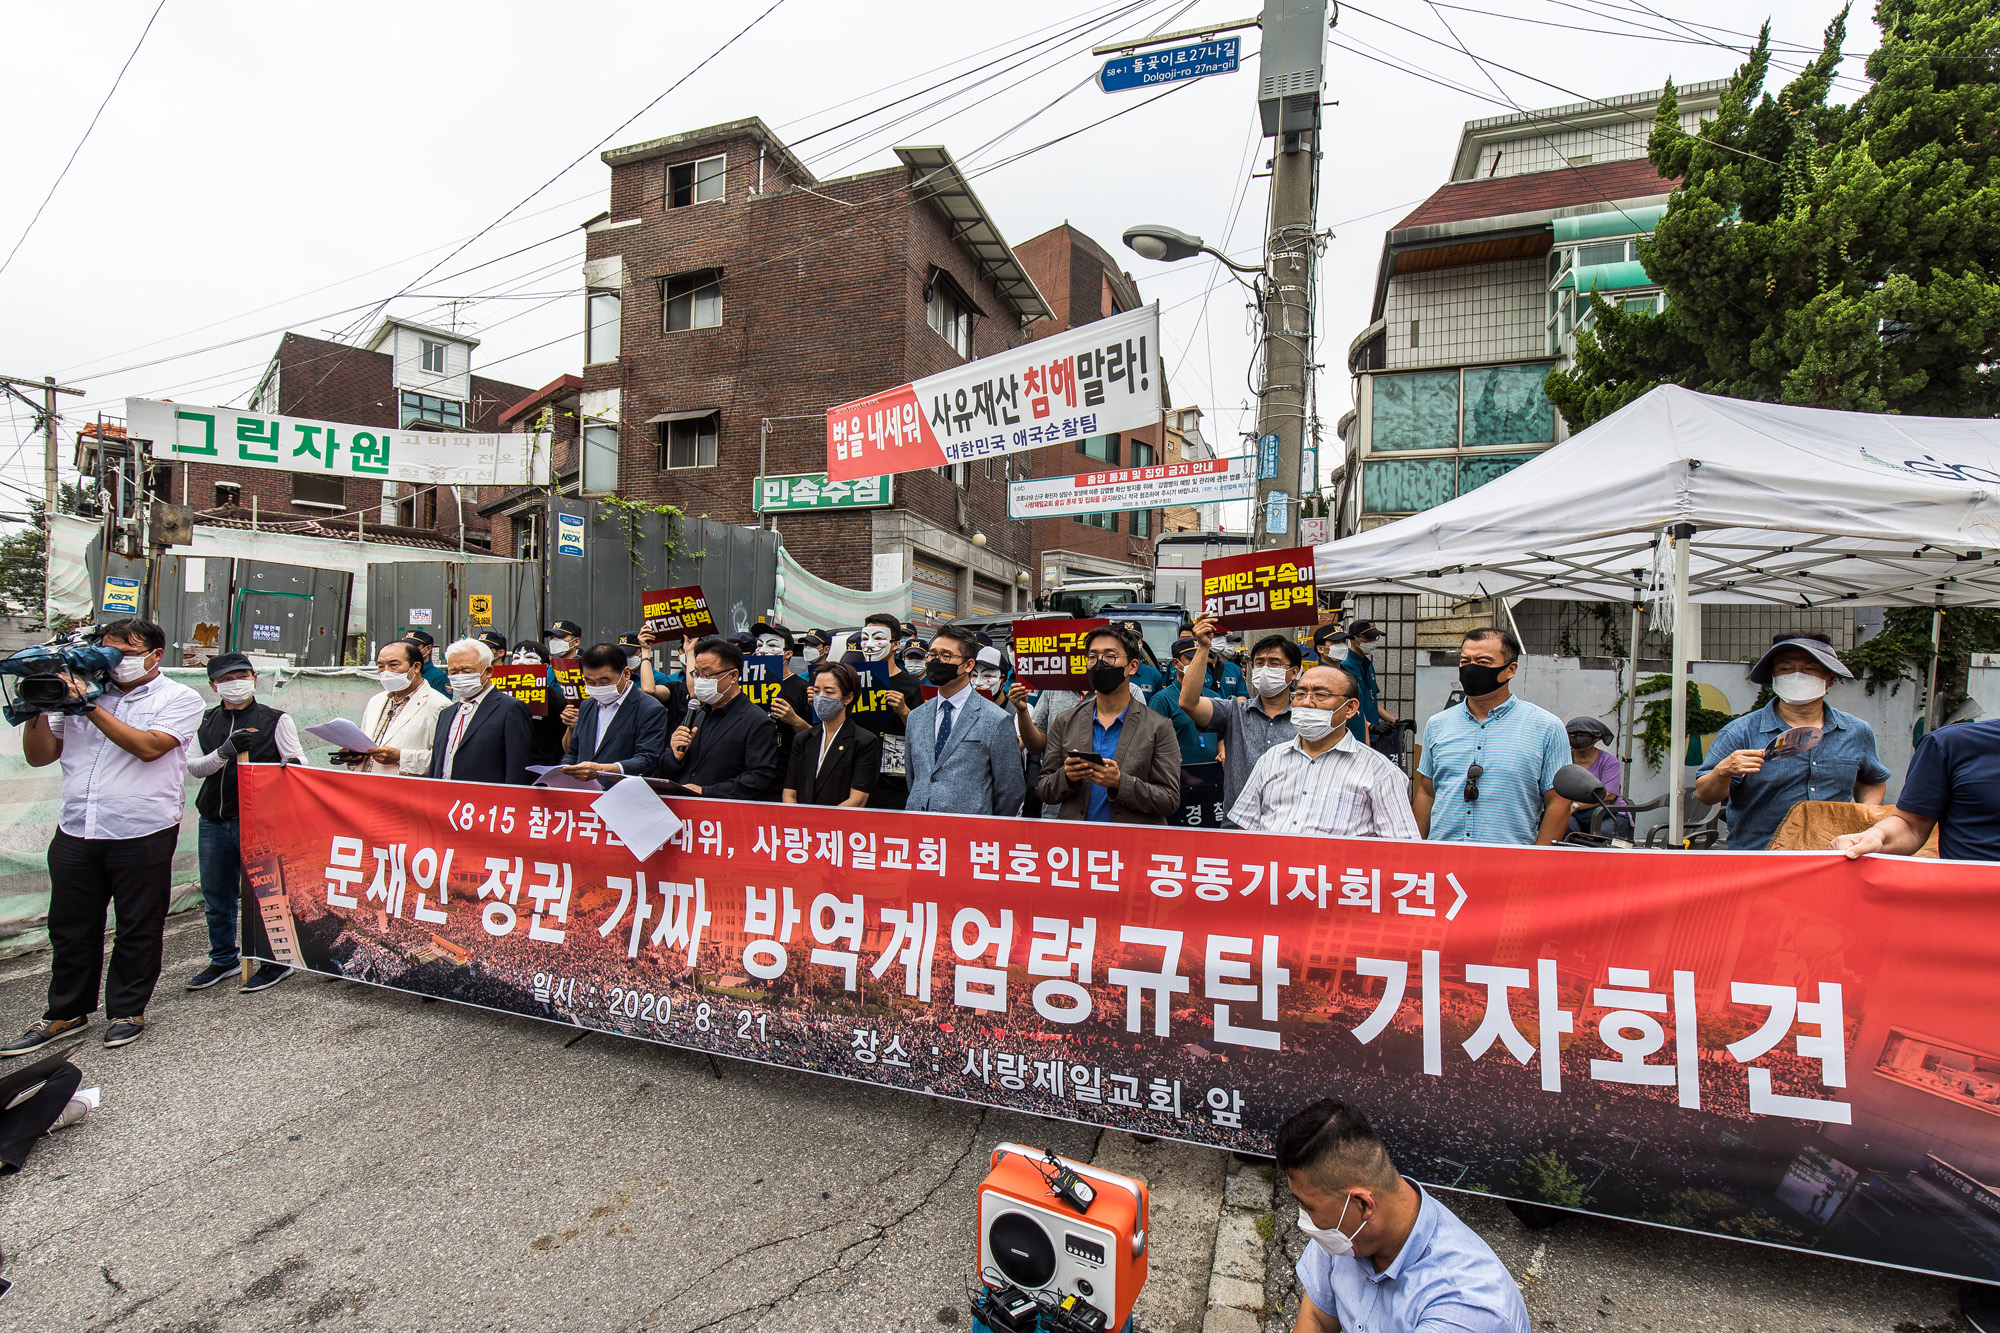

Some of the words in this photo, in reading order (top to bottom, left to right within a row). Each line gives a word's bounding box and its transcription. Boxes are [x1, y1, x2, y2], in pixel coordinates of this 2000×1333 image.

[1132, 40, 1236, 73] 돌곶이로27나길
[1106, 68, 1116, 76] 58
[1143, 68, 1192, 83] Dolgoji-ro
[1194, 59, 1235, 74] 27na-gil
[832, 416, 864, 460] 법을
[868, 401, 922, 451] 내세워
[932, 373, 1020, 437] 사유재산
[1024, 335, 1149, 420] 침해말라!
[172, 410, 390, 474] 그린자원
[946, 434, 1006, 460] 대한민국
[1012, 413, 1098, 447] 애국순찰팀
[1088, 474, 1106, 484] 출입
[1110, 471, 1128, 482] 통제
[1132, 470, 1141, 480] 및
[1145, 467, 1164, 479] 집회
[1168, 464, 1188, 476] 금지
[1192, 462, 1214, 474] 안내
[764, 476, 881, 507] 민속주점
[562, 533, 581, 543] NSOK
[1204, 570, 1254, 596] 문재인
[1256, 562, 1313, 588] 구속이
[108, 592, 134, 601] NSOK
[644, 602, 672, 618] 문재인
[670, 596, 706, 614] 구속이
[1205, 592, 1266, 618] 최고의
[1270, 584, 1314, 610] 방역
[646, 616, 684, 633] 최고의
[682, 610, 712, 628] 방역
[1016, 636, 1058, 654] 문재인
[1018, 656, 1066, 675] 최고의
[507, 674, 546, 688] 구속이
[516, 689, 546, 704] 방역
[1186, 801, 1224, 825] 경찰
[752, 825, 947, 877] 사랑제일교회
[970, 840, 1124, 892] 변호인단
[325, 835, 455, 924] 문재인
[477, 856, 573, 944] 정권
[598, 871, 712, 967] 가짜
[742, 885, 1290, 1052] 방역계엄령규탄
[1351, 949, 1852, 1124] 기자회견
[533, 972, 576, 1008] 일시
[610, 987, 680, 1028] 2020.
[696, 1002, 721, 1036] 8.
[737, 1009, 780, 1046] 21.
[850, 1028, 911, 1068] 장소
[961, 1047, 1182, 1119] 사랑제일교회
[1206, 1088, 1245, 1129] 앞
